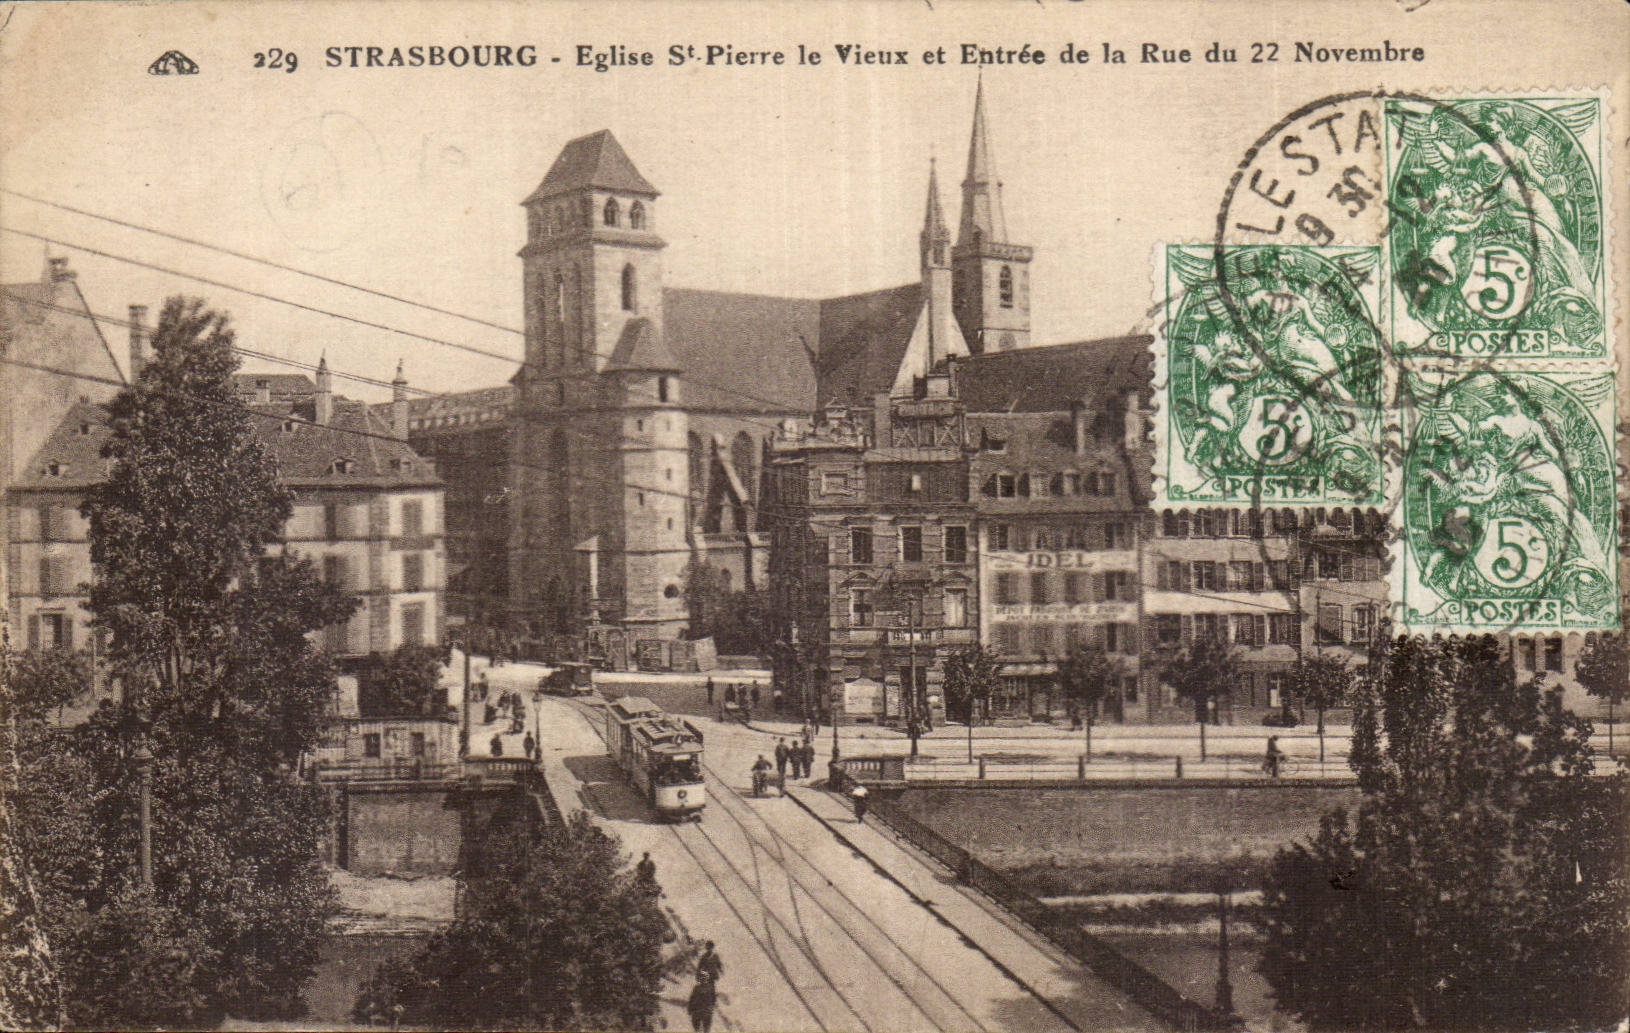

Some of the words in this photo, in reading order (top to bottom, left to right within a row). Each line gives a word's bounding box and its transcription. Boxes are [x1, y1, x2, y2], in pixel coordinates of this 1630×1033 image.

[1454, 332, 1546, 355] POSTES
[1229, 477, 1320, 499] POSTES
[1464, 601, 1558, 622] POSTES
